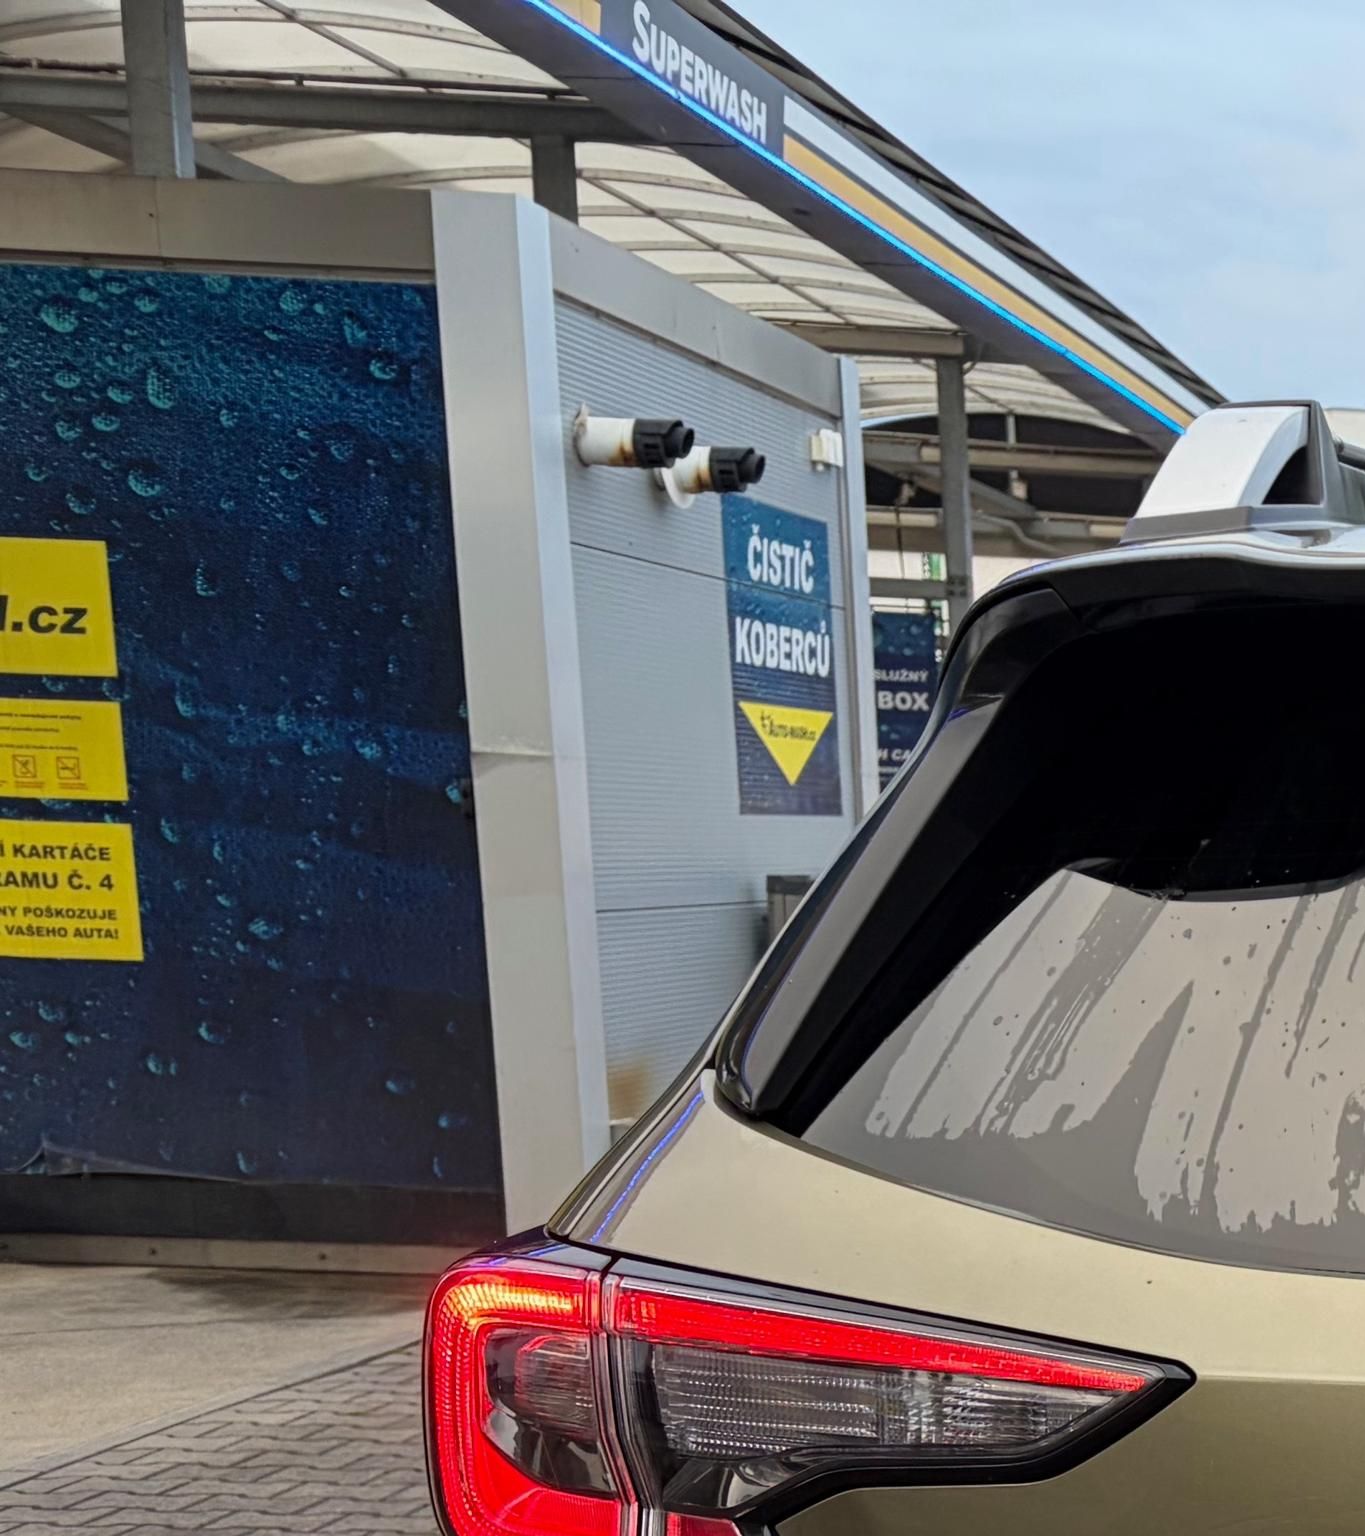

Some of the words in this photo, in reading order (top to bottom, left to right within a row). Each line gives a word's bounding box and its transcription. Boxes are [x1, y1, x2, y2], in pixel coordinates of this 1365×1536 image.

[748, 524, 814, 594] ČISTIČ
[735, 616, 831, 677] KOBERCŮ
[878, 690, 930, 712] BOX
[13, 842, 112, 861] KARTÁČE
[67, 868, 91, 890] Č.
[99, 874, 114, 891] 4
[23, 905, 118, 921] POŠKOZUJE
[5, 924, 68, 938] VAŠEHO
[73, 927, 119, 940] AUTA!
